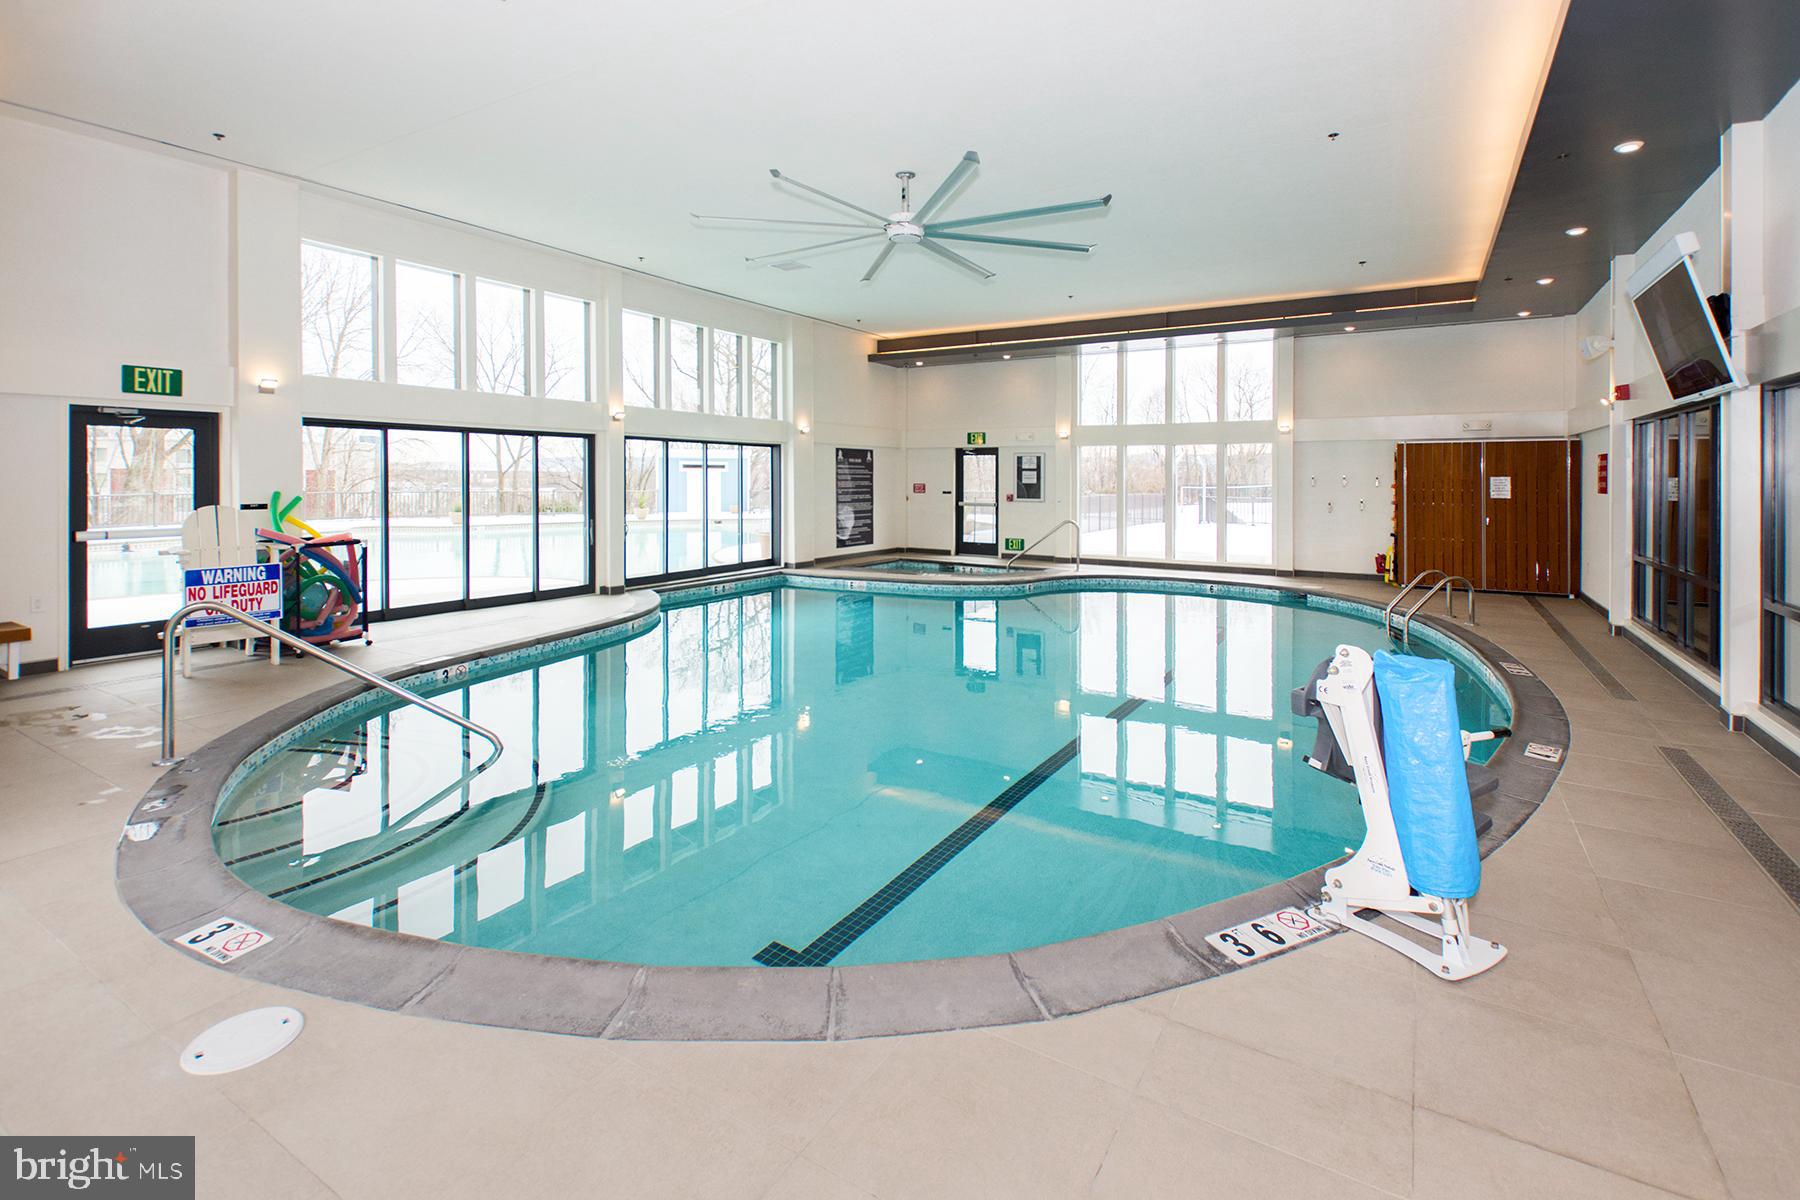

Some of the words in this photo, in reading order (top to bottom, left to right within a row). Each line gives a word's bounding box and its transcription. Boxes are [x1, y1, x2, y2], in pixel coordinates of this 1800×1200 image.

[134, 367, 174, 394] EXIT
[1009, 539, 1022, 550] EXIT
[201, 565, 267, 585] WARNING
[188, 586, 207, 601] NO
[212, 580, 279, 599] LIFEGUARD
[231, 597, 264, 612] DUTY
[188, 922, 235, 945] 3
[1219, 933, 1256, 957] 3
[1251, 923, 1286, 945] 6
